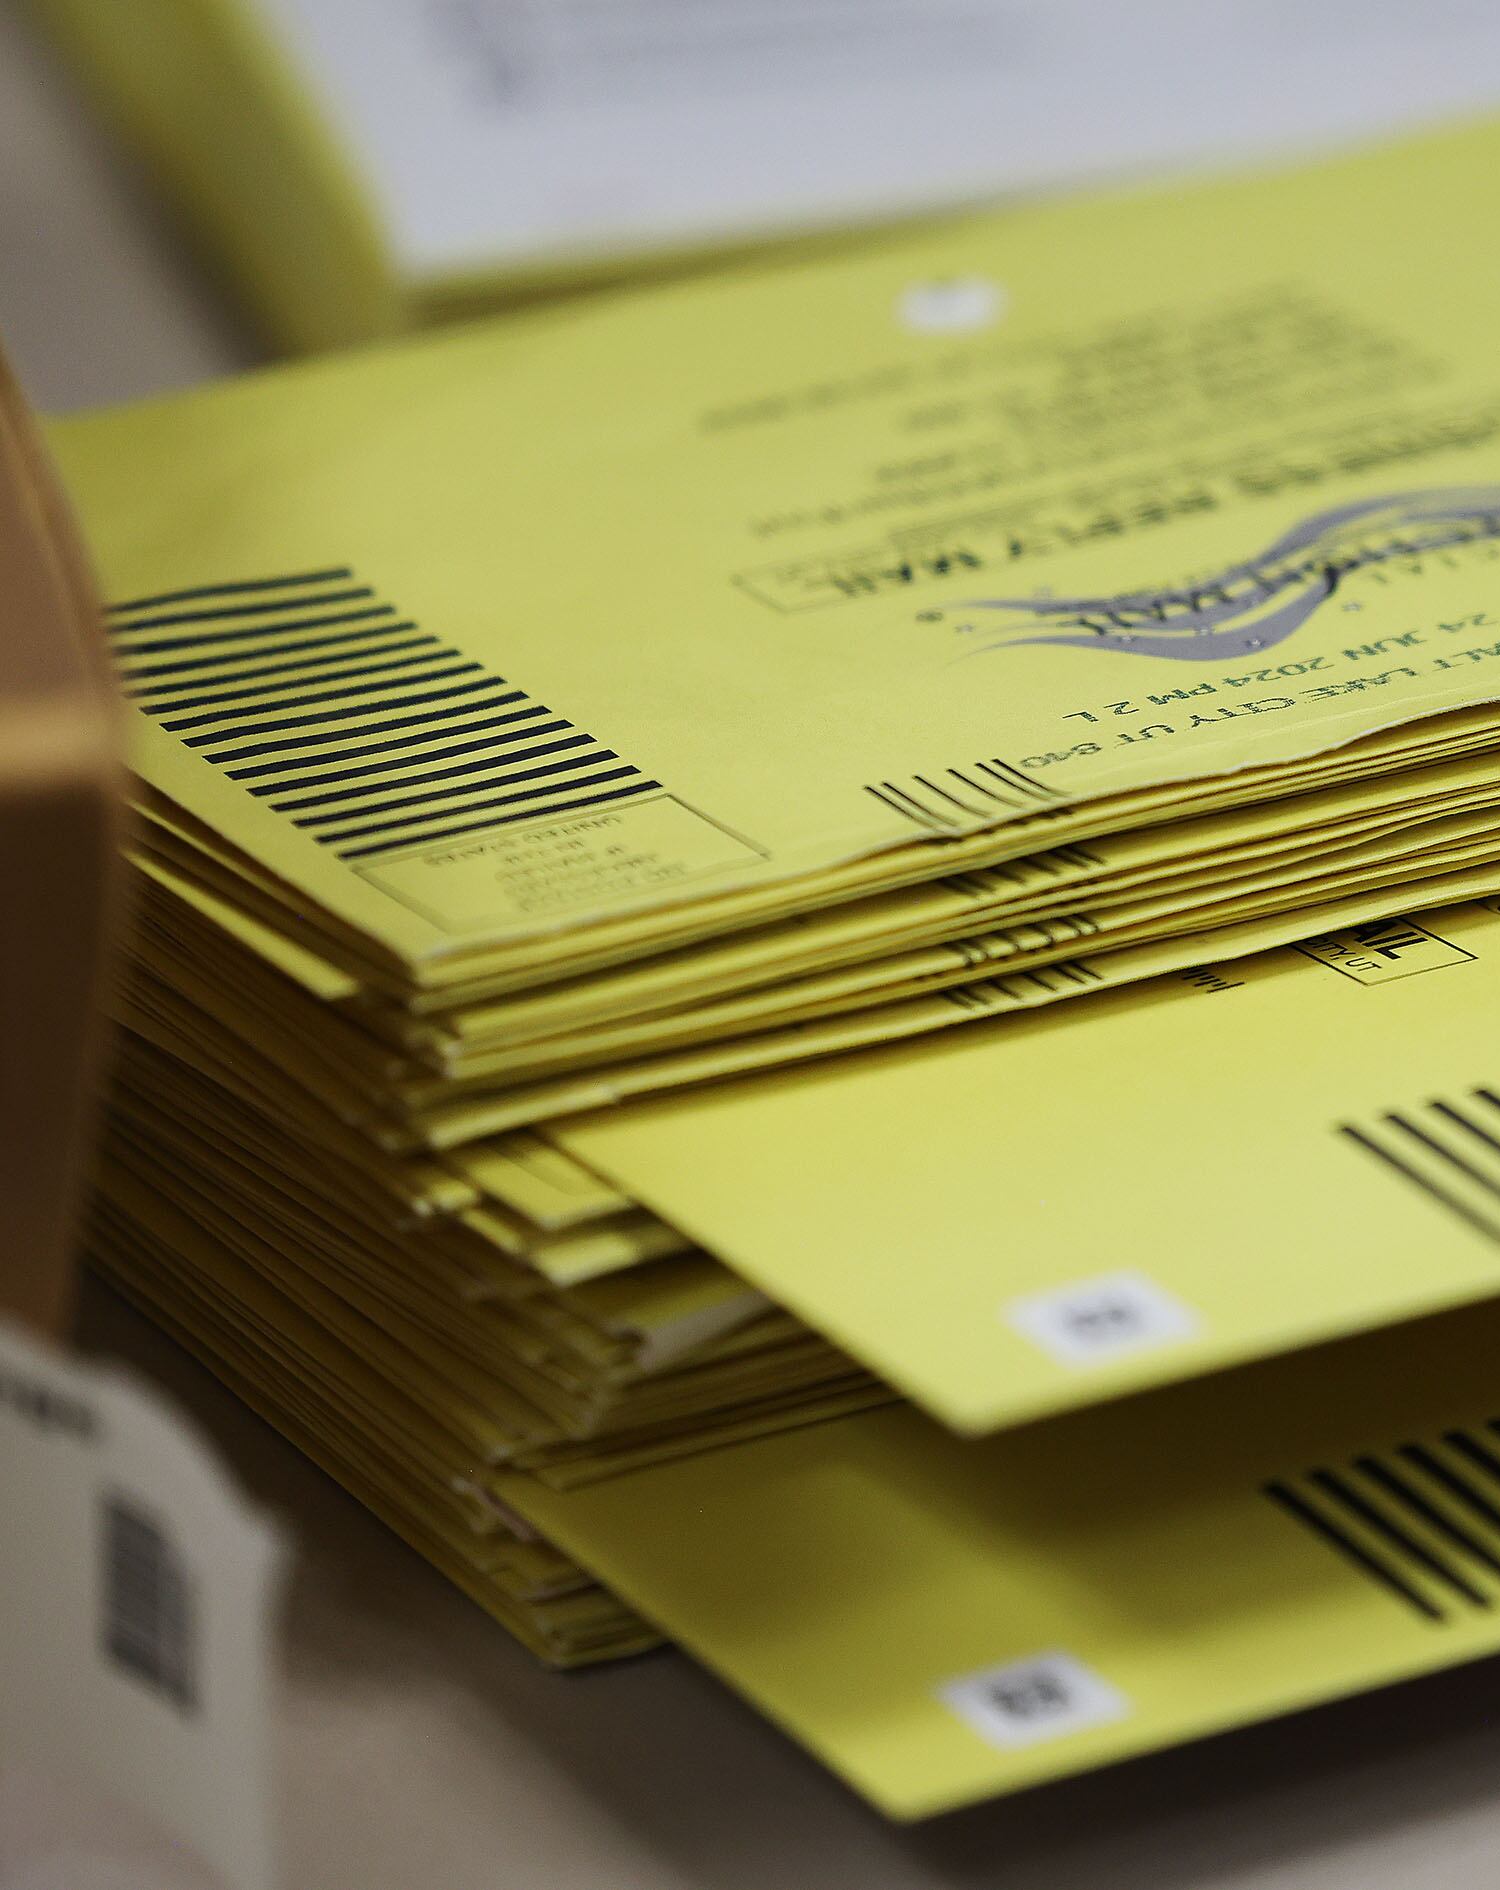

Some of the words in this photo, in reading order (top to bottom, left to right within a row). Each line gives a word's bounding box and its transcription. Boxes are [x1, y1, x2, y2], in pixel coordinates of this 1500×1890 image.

[1437, 614, 1498, 634] 24
[1342, 629, 1428, 662] JUN
[1222, 656, 1335, 688] 2024
[1298, 667, 1419, 704] LAKE
[1146, 682, 1218, 706] PM
[1062, 711, 1099, 723] L
[1103, 701, 1139, 716] 2
[1184, 696, 1296, 732] CITY
[1113, 723, 1176, 750] UT
[1354, 917, 1429, 961] AIL
[1345, 956, 1383, 973] UT
